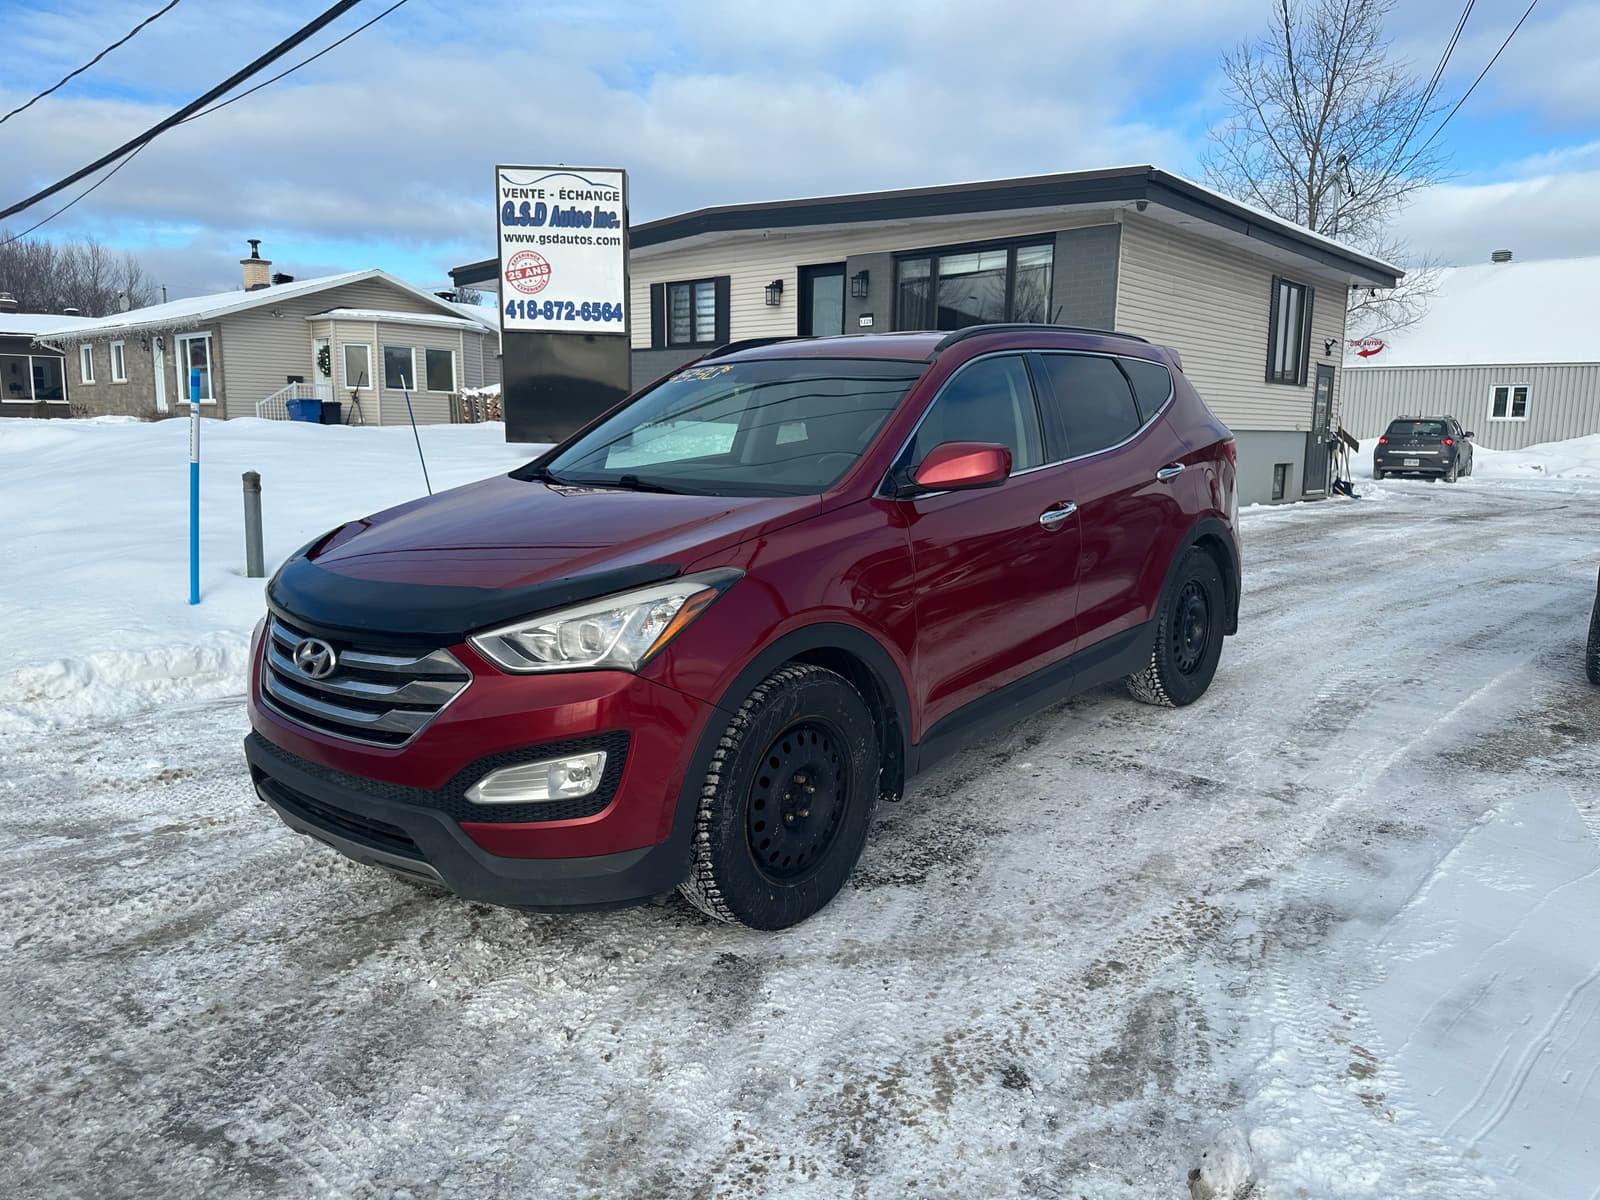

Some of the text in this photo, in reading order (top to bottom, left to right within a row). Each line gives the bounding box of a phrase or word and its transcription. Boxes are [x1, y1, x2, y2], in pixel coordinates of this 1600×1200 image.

[502, 187, 545, 199] VENTE
[559, 187, 620, 201] ÉCHANGE
[549, 205, 593, 229] Autos
[504, 233, 621, 246] www.gsdautos.com
[508, 265, 549, 280] 25 ANS
[505, 299, 623, 322] 418-872-6564
